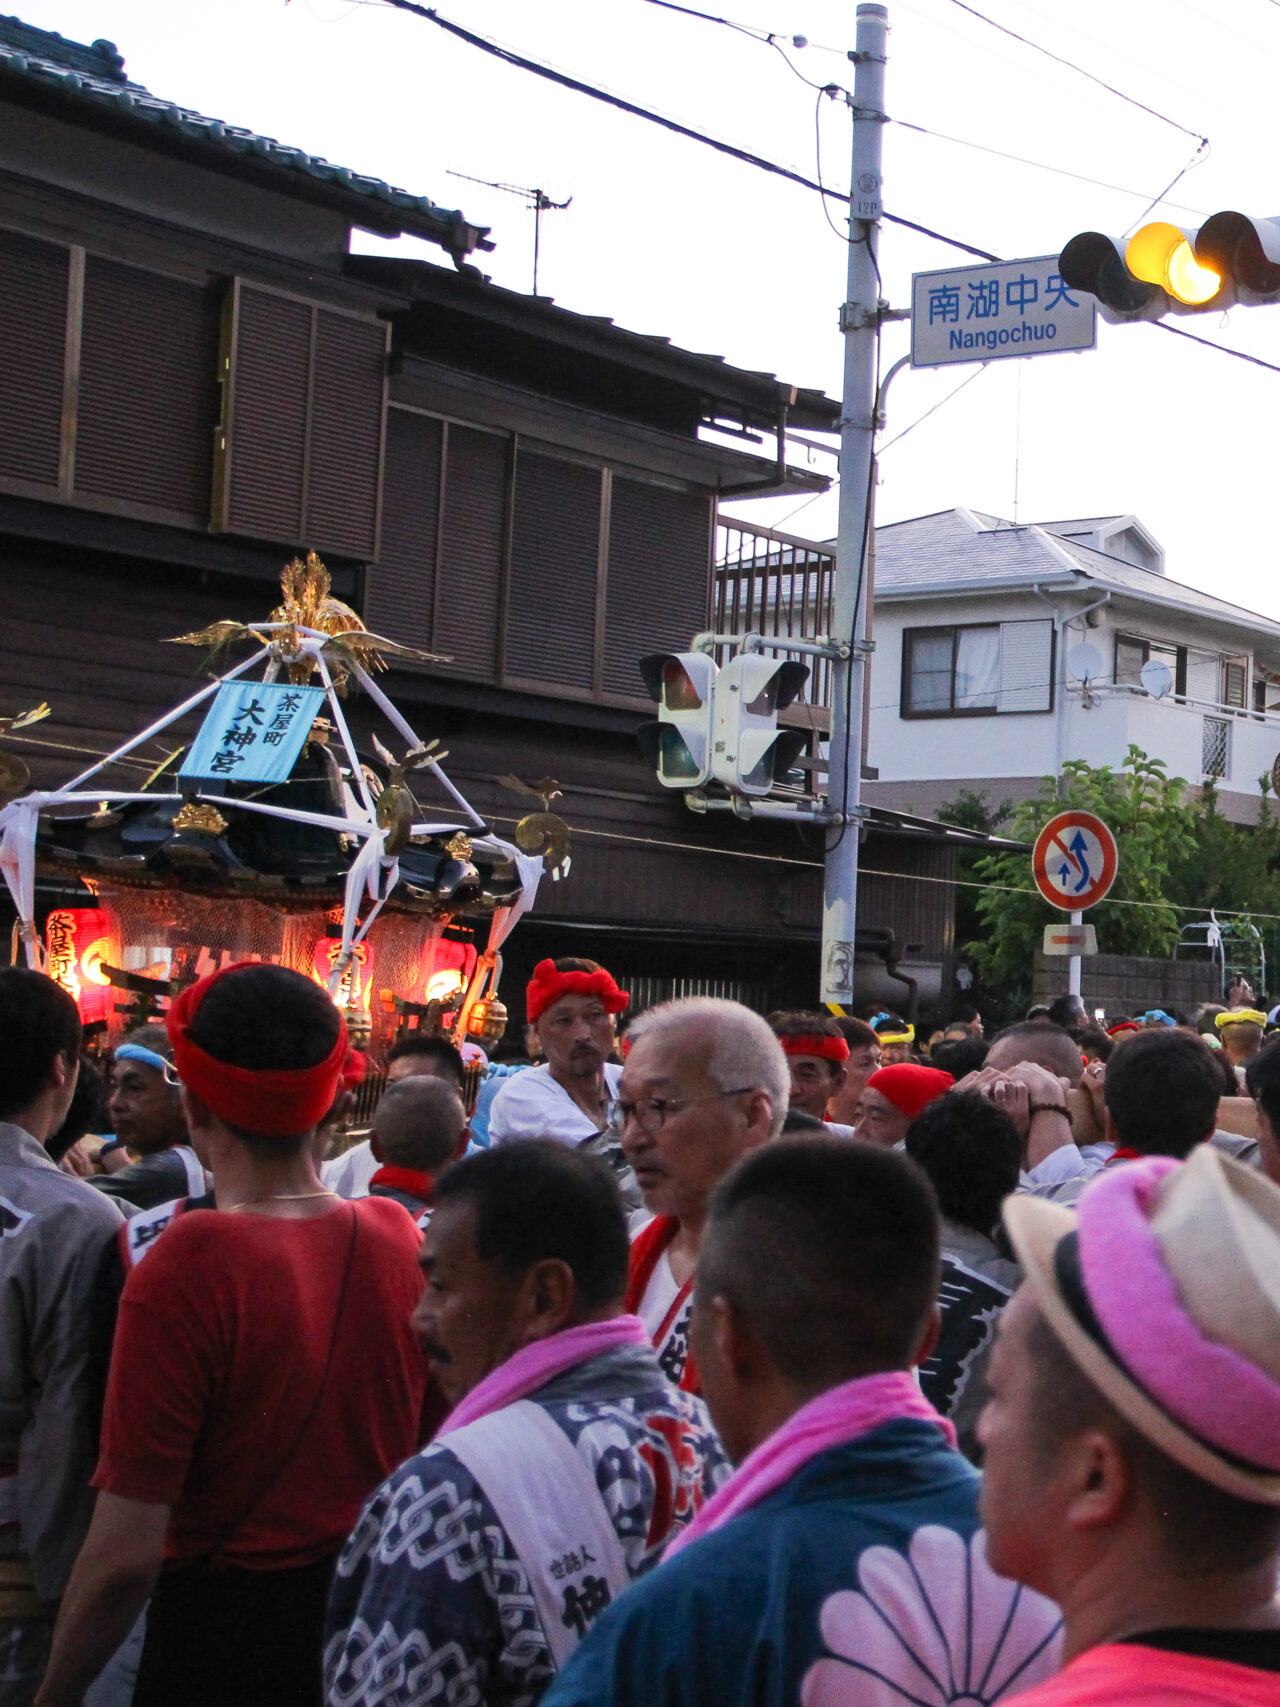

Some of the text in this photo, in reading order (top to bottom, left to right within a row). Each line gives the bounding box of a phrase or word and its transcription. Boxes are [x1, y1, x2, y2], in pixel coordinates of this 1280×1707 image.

[928, 273, 1079, 326] 南湖中央
[950, 321, 1057, 350] Nangochuo
[210, 699, 265, 774] 大神宮
[263, 693, 302, 747] 茶屋町
